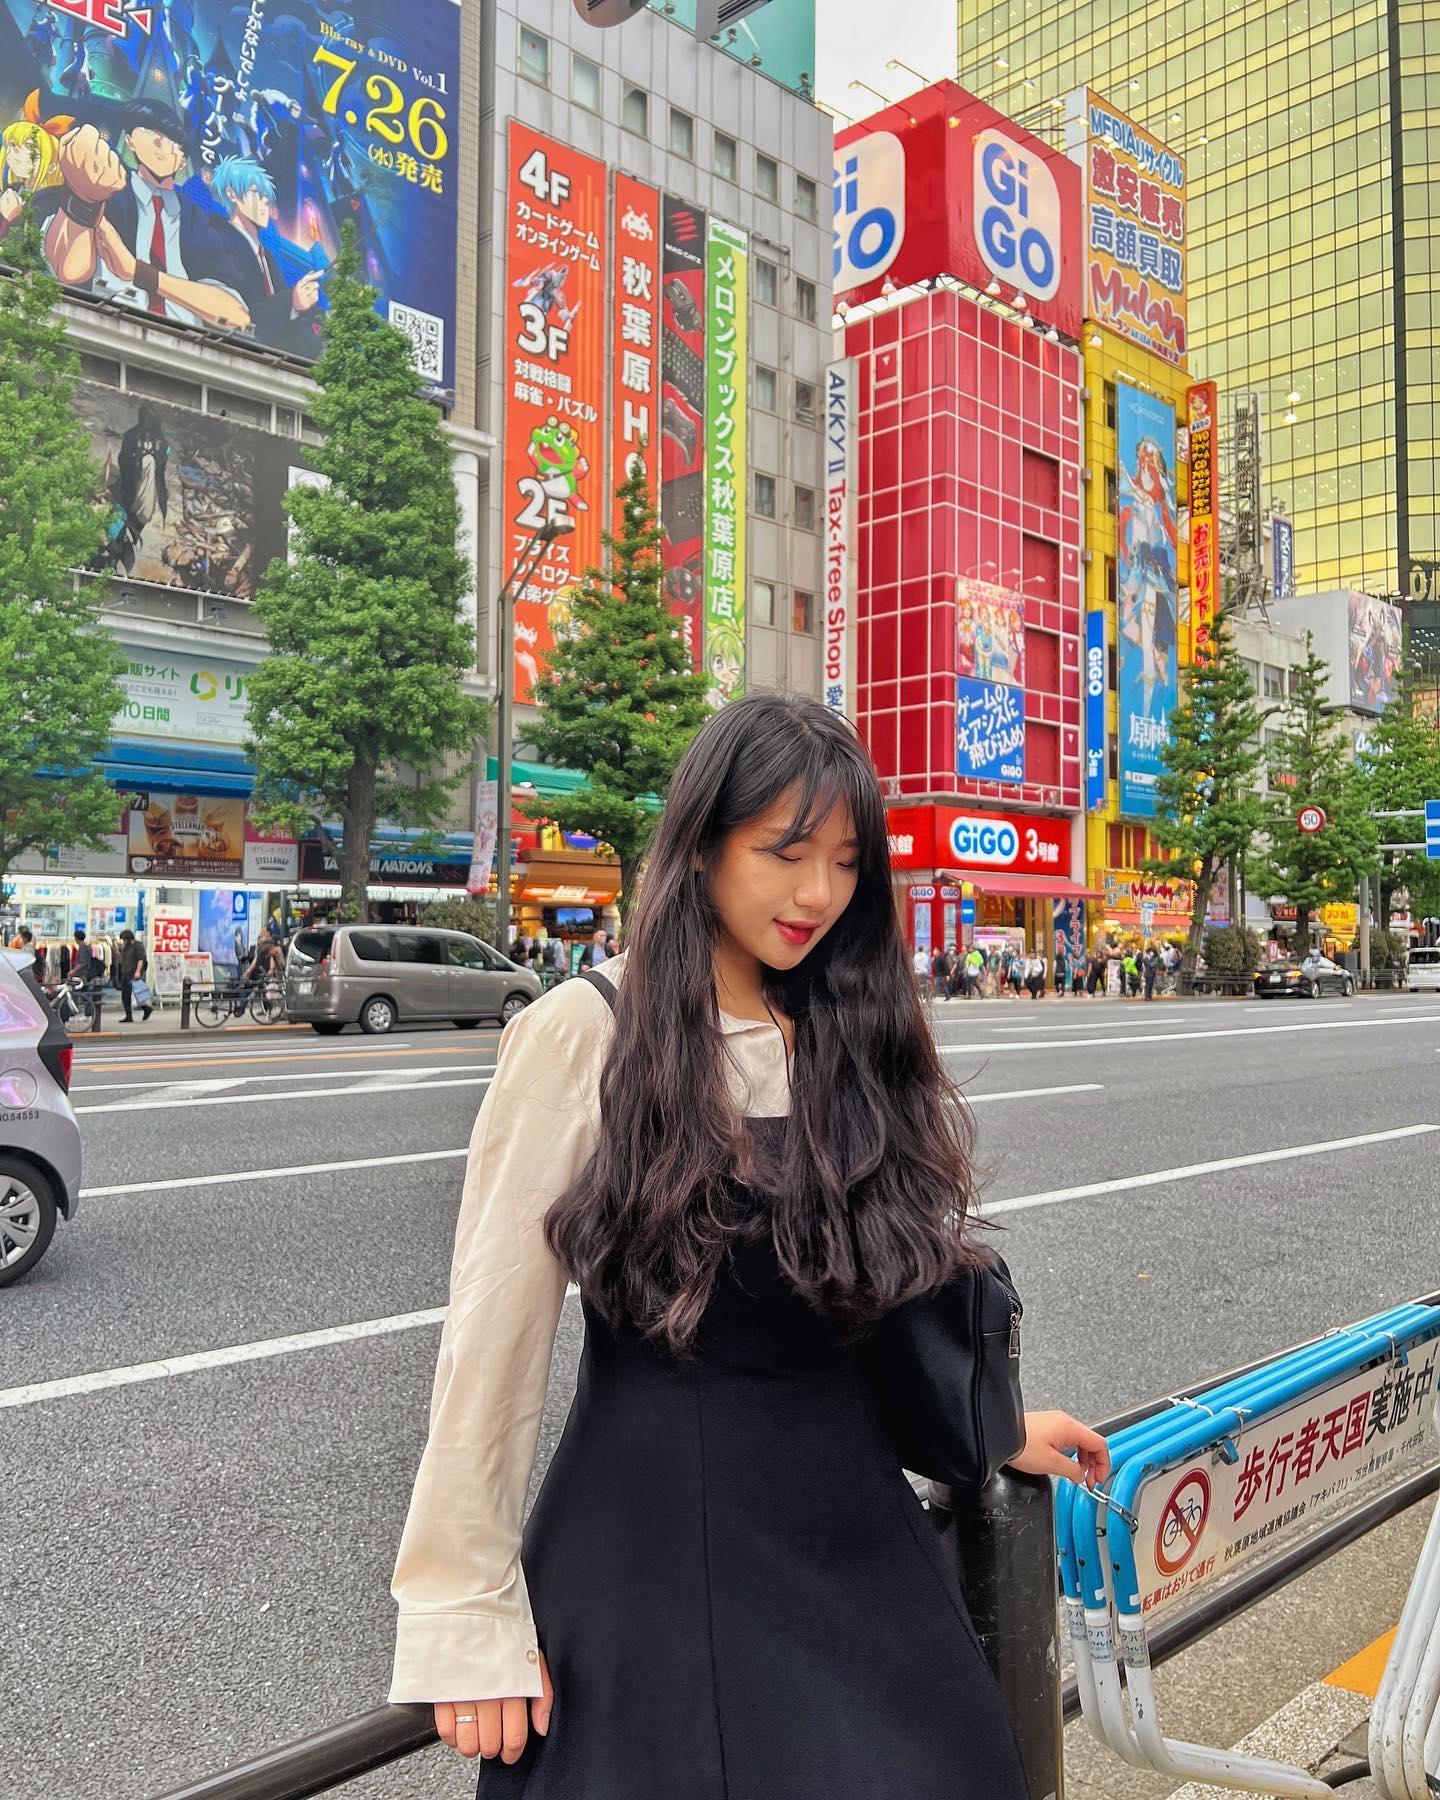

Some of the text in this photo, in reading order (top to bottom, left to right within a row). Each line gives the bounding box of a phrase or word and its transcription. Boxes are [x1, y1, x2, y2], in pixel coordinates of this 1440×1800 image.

[319, 21, 365, 54] Blu-ray
[378, 50, 408, 72] DVD
[312, 45, 448, 160] 7.26
[519, 149, 570, 206] 4F
[516, 223, 600, 272] オンラインゲーム
[517, 200, 600, 250] カードゲーム
[1090, 204, 1184, 291] 高額買取
[517, 302, 568, 361] 3F
[828, 370, 846, 454] AKKY
[711, 256, 737, 620] メロンブックス秋葉原店
[828, 477, 846, 602] Tax-free
[826, 606, 846, 681] Shop
[957, 685, 1010, 722] ゲームの
[954, 823, 1015, 857] GiGO
[1304, 812, 1318, 826] 50
[381, 858, 433, 875] NATIONS
[1025, 828, 1060, 864] 3号館
[155, 921, 189, 938] Tax
[155, 937, 189, 953] Free
[1233, 1362, 1434, 1522] 歩行者天国実施中
